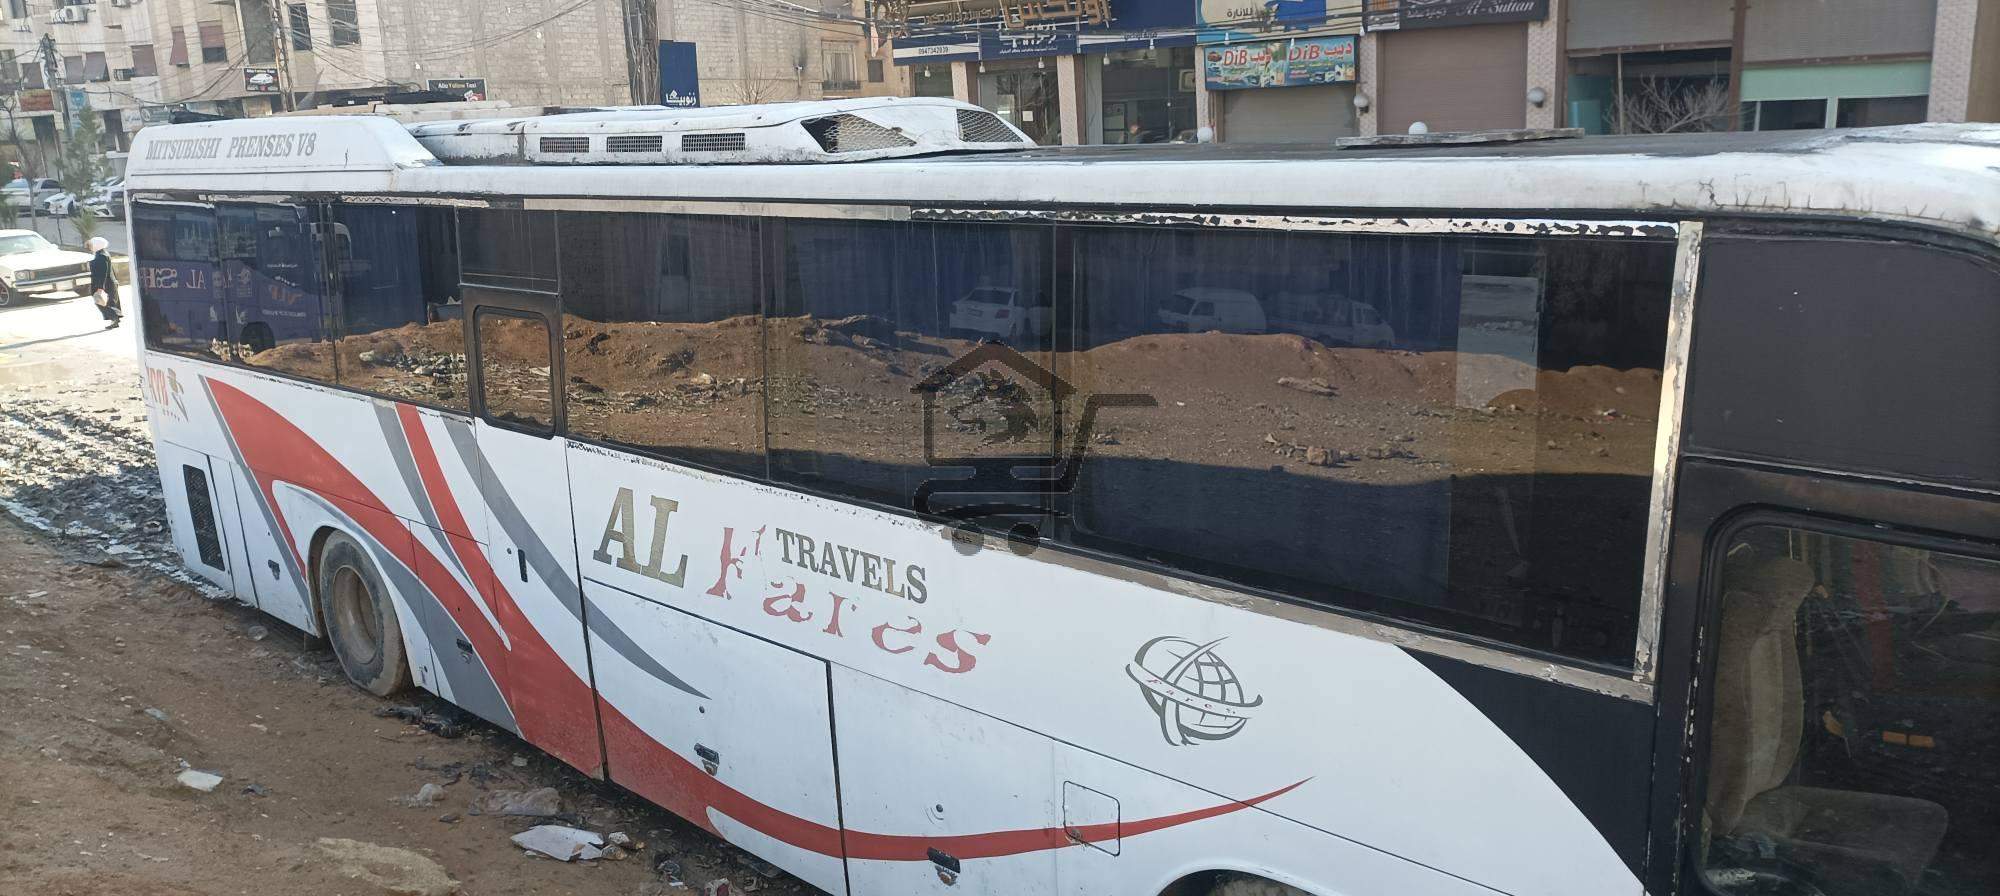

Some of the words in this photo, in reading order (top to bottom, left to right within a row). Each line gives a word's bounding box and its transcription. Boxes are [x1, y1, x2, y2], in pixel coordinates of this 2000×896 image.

[1223, 48, 1248, 66] DiB
[1288, 44, 1321, 62] DiB
[1323, 42, 1353, 60] ديب
[145, 137, 222, 160] MITSUBISHI
[226, 133, 295, 159] PRENSES
[297, 132, 317, 156] V8
[775, 527, 928, 604] TRAVELS
[593, 486, 688, 589] AL
[706, 524, 991, 674] Fares
